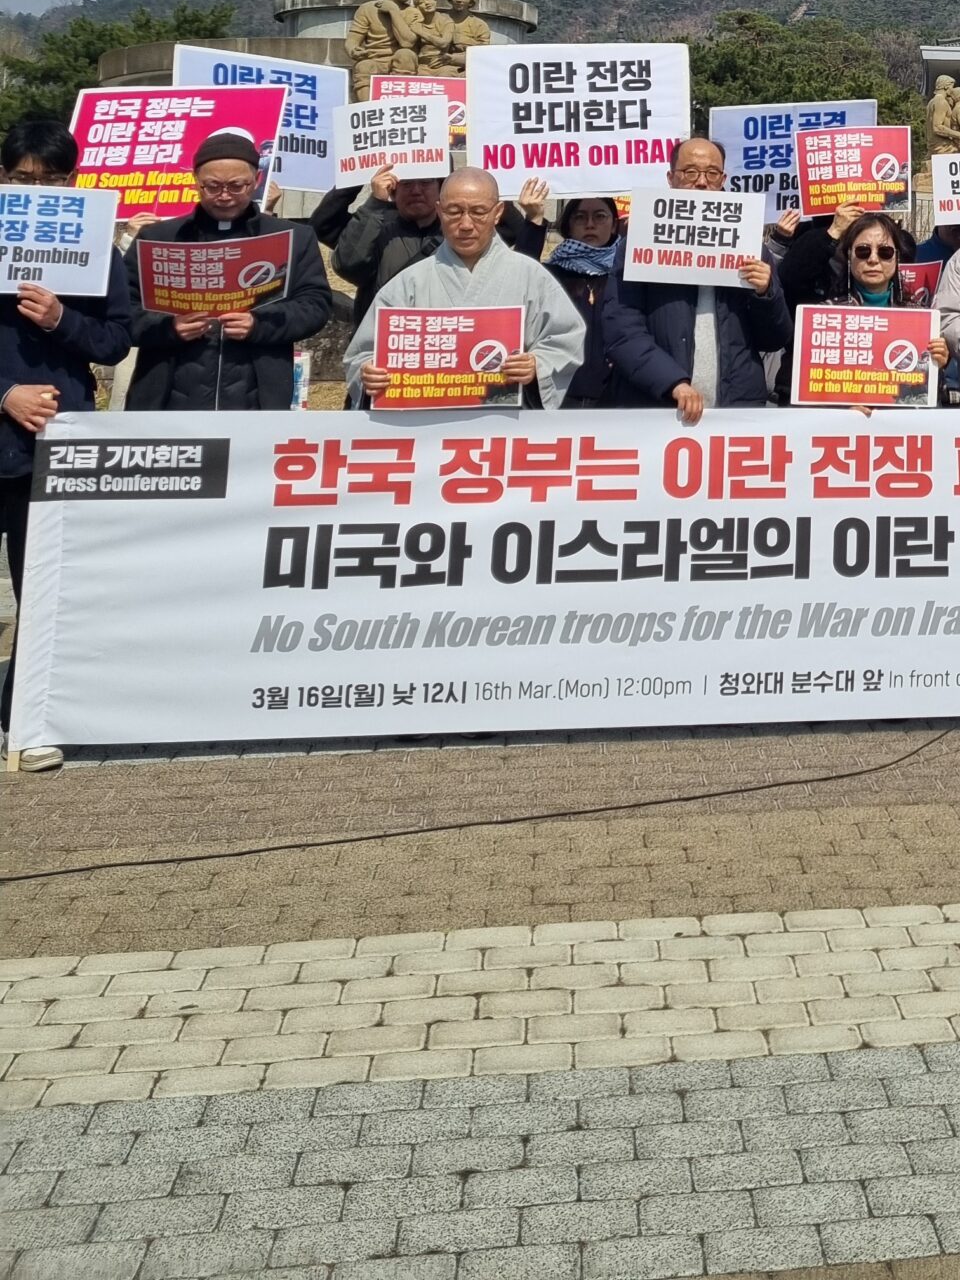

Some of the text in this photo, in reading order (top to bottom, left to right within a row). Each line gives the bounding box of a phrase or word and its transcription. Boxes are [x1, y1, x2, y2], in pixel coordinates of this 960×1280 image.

[509, 59, 652, 94] 이란 전쟁
[93, 96, 215, 120] 한국 정부는
[350, 105, 427, 129] 이란 전쟁
[512, 98, 652, 135] 반대한다
[87, 120, 186, 143] 이란 전쟁
[743, 113, 794, 140] 이란
[353, 127, 427, 151] 반대한다
[80, 144, 183, 167] 파병 말라
[340, 148, 444, 173] NO WAR on IRAN
[483, 144, 516, 170] NO
[522, 142, 580, 168] WAR
[588, 144, 619, 166] on
[743, 144, 793, 171] 당장
[99, 172, 145, 188] South
[731, 174, 775, 193] STOP
[37, 194, 85, 218] 공격
[653, 198, 697, 221] 이란
[701, 201, 743, 223] 전쟁
[34, 221, 83, 244] 중단
[653, 223, 740, 249] 반대한다
[12, 246, 90, 267] Bombing
[632, 247, 716, 268] NO WAR on
[7, 264, 43, 281] Iran
[389, 315, 475, 333] 한국 정부는
[812, 313, 889, 332] 한국 정부는
[388, 335, 457, 351] 이란 전쟁
[811, 331, 873, 348] 이란 전쟁
[386, 353, 458, 369] 파병 말라
[810, 348, 873, 365] 파병 말라
[810, 368, 924, 383] NO South Korean Troops
[809, 381, 898, 395] for the War on Iran
[50, 445, 202, 469] 긴급 기자회견
[273, 438, 416, 507] 한국
[439, 436, 640, 503] 정부는
[662, 435, 793, 500] 이란
[810, 435, 933, 499] 전쟁
[46, 474, 201, 493] Press Conference
[263, 521, 472, 589] 미국와
[490, 517, 811, 585] 이스라엘의
[833, 515, 955, 579] 이란
[250, 614, 304, 653] No
[307, 612, 420, 652] South
[422, 610, 556, 648] Korean
[558, 610, 677, 647] troops
[678, 604, 733, 641] for
[735, 604, 793, 640] the
[797, 602, 868, 638] War
[870, 605, 915, 637] on
[252, 686, 289, 710] 3월
[297, 683, 384, 709] 16일(월)
[392, 682, 417, 706] 낮
[422, 681, 467, 704] 12시
[474, 681, 512, 701] 16th
[616, 677, 692, 699] 12:00pm
[719, 672, 784, 696] 청와대
[791, 670, 855, 694] 분수대
[862, 669, 884, 692] 앞
[889, 670, 904, 689] In
[909, 669, 950, 688] front
